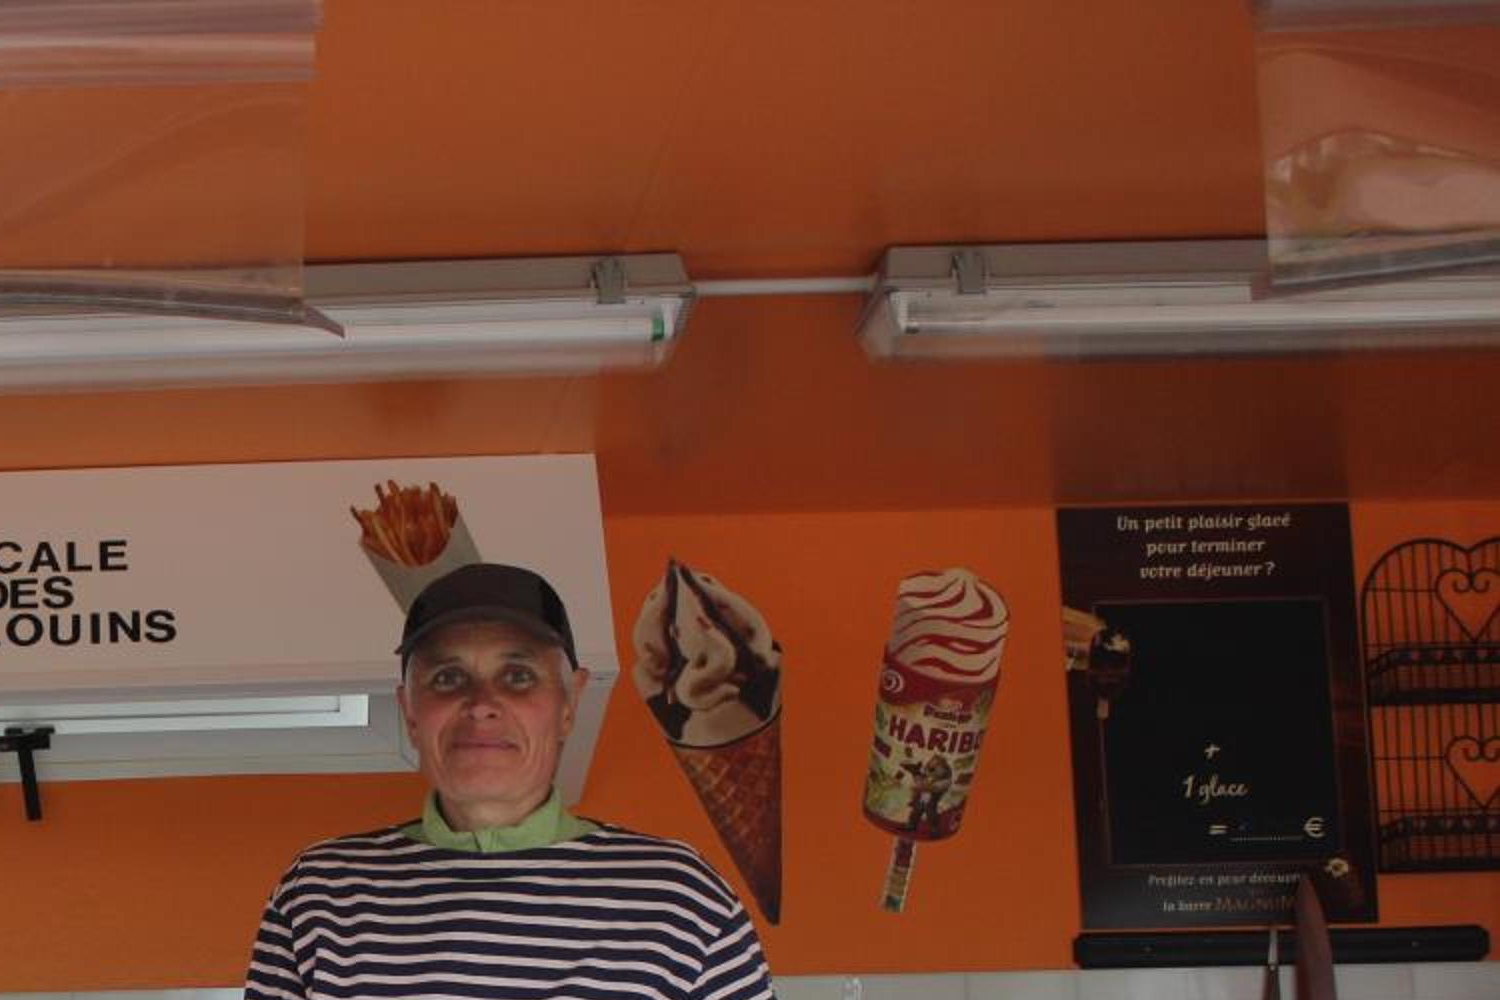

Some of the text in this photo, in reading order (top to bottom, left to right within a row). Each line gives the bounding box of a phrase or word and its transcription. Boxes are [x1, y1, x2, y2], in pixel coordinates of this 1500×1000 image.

[1117, 512, 1291, 533] Un petit plaisir glacé
[1146, 538, 1266, 557] pour terminer
[1139, 566, 1182, 579] votre
[1198, 775, 1249, 804] glace
